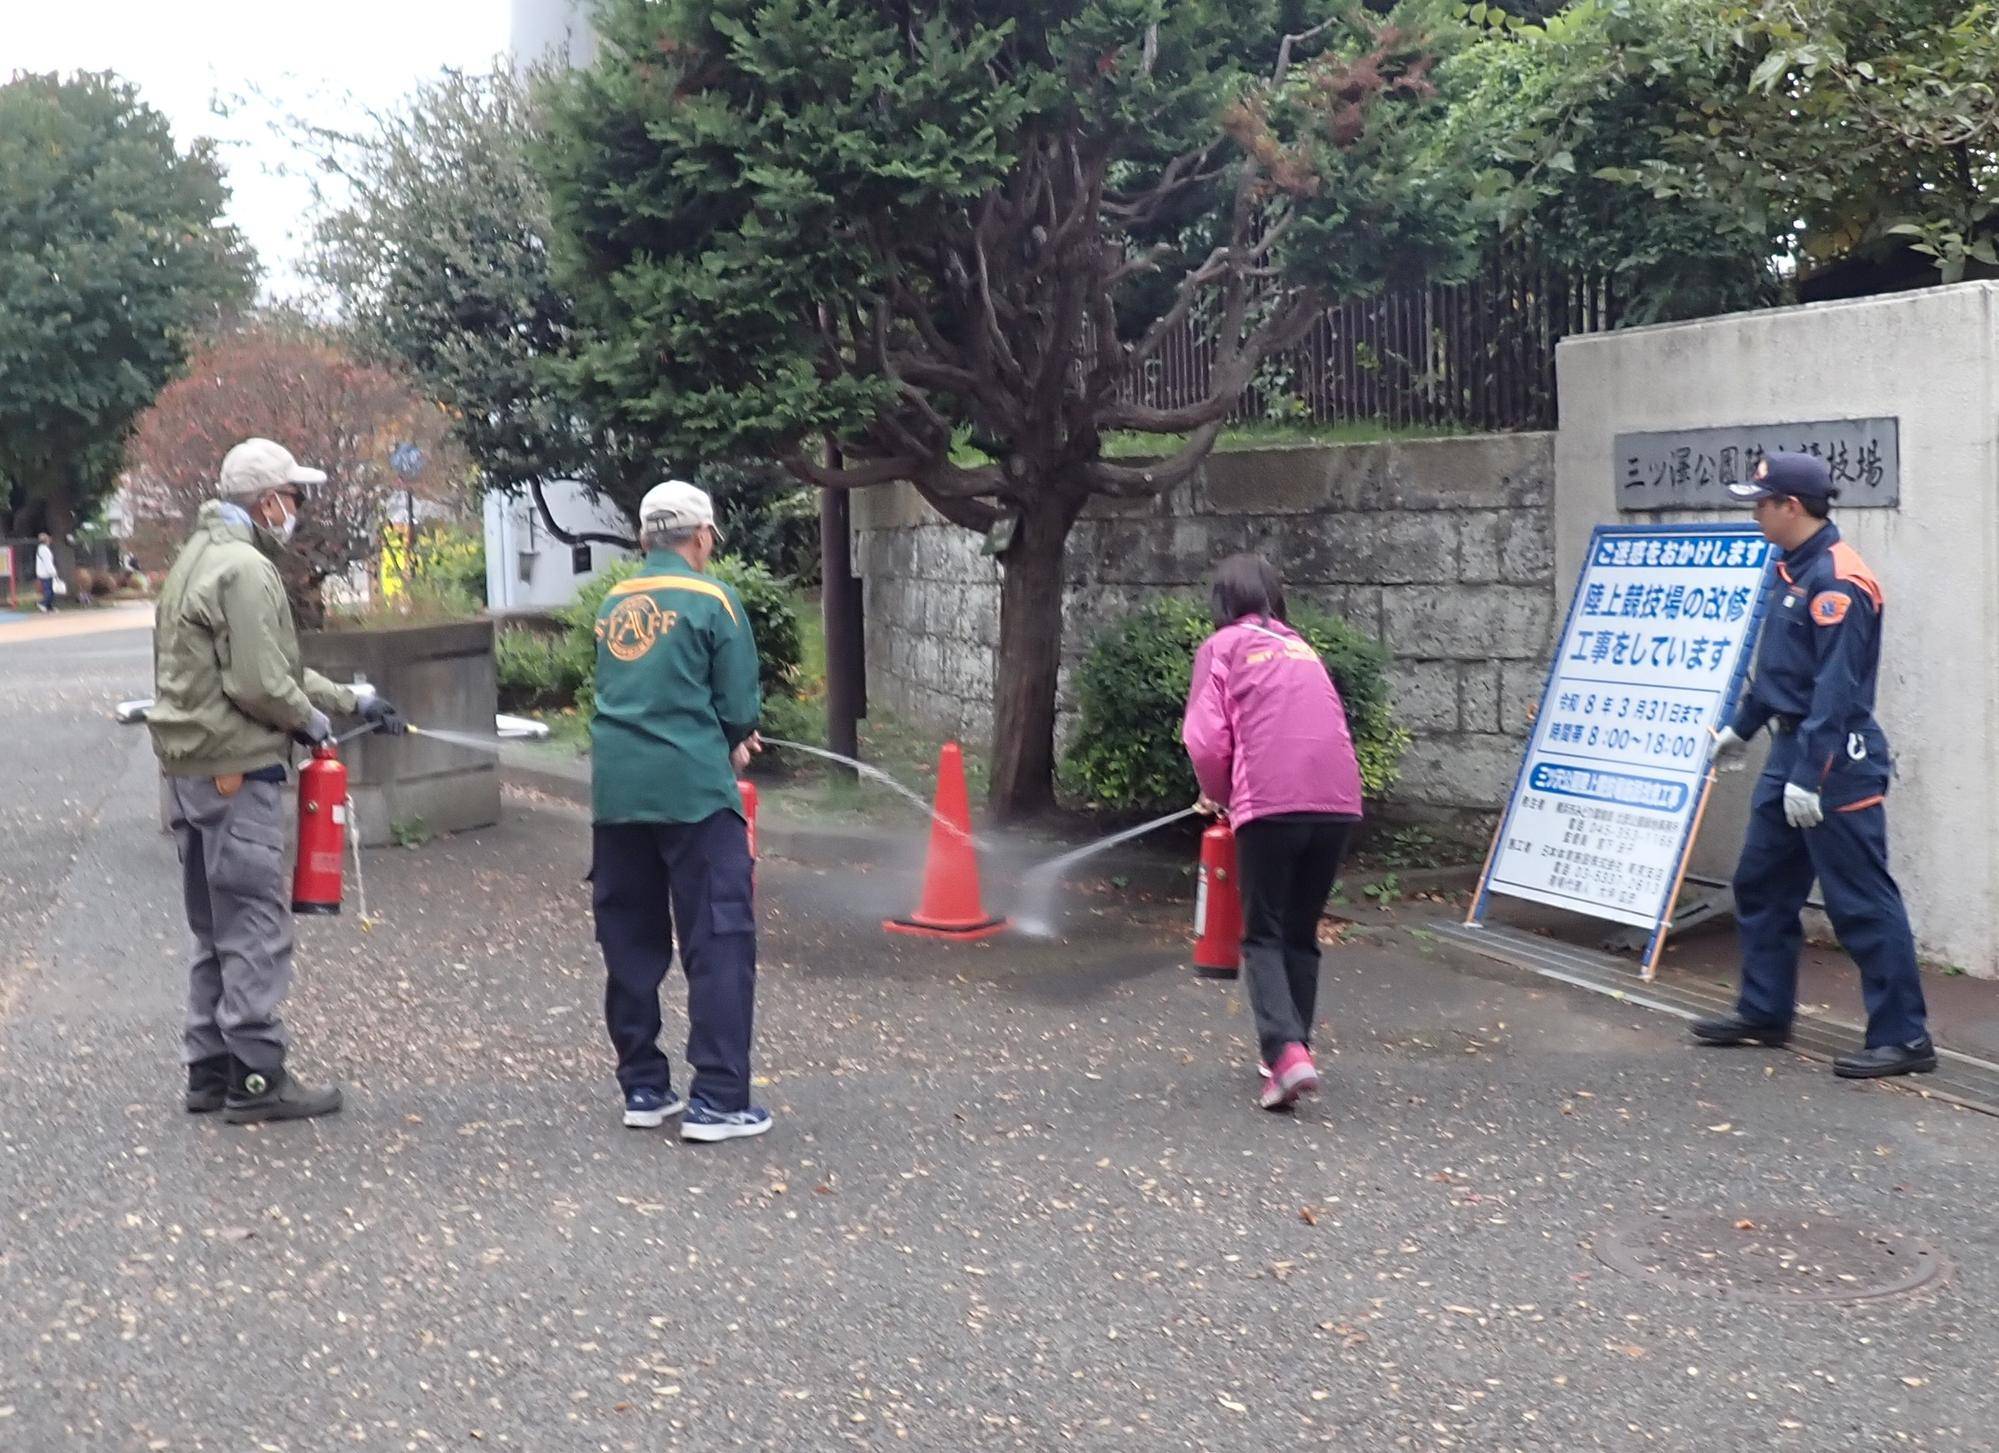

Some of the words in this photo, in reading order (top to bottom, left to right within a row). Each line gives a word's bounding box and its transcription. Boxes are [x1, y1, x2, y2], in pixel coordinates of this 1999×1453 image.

[1599, 540, 1765, 566] ご迷惑をおかけします
[1581, 583, 1751, 622] 陸上競技場の改修
[1570, 630, 1732, 671] 工事をしています
